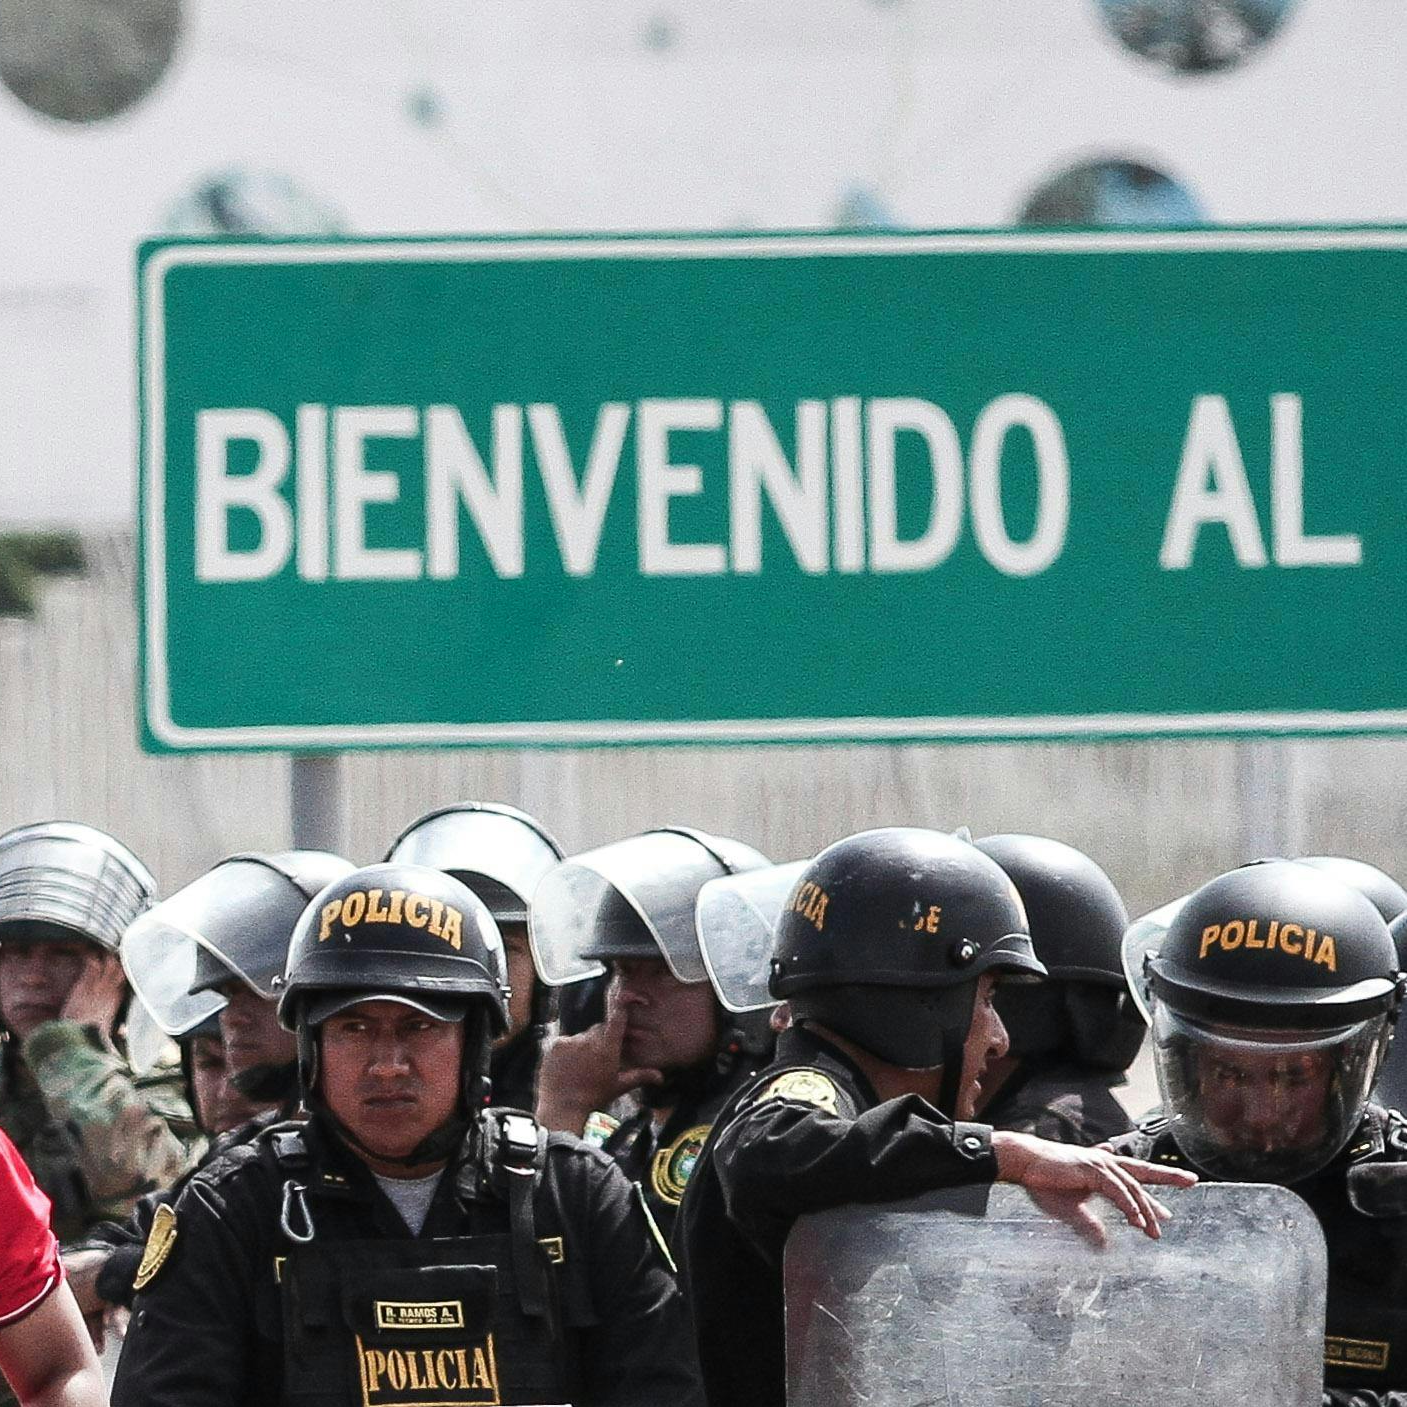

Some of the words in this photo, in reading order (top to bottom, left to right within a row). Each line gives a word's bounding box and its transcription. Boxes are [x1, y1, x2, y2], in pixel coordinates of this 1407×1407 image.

[194, 393, 1072, 584] BIENVENIDO
[1159, 392, 1363, 570] AL
[319, 890, 464, 951] POLICIA
[1200, 919, 1337, 971] POLICIA
[400, 1307, 437, 1317] RAMOS
[365, 1346, 494, 1392] POLICIA
